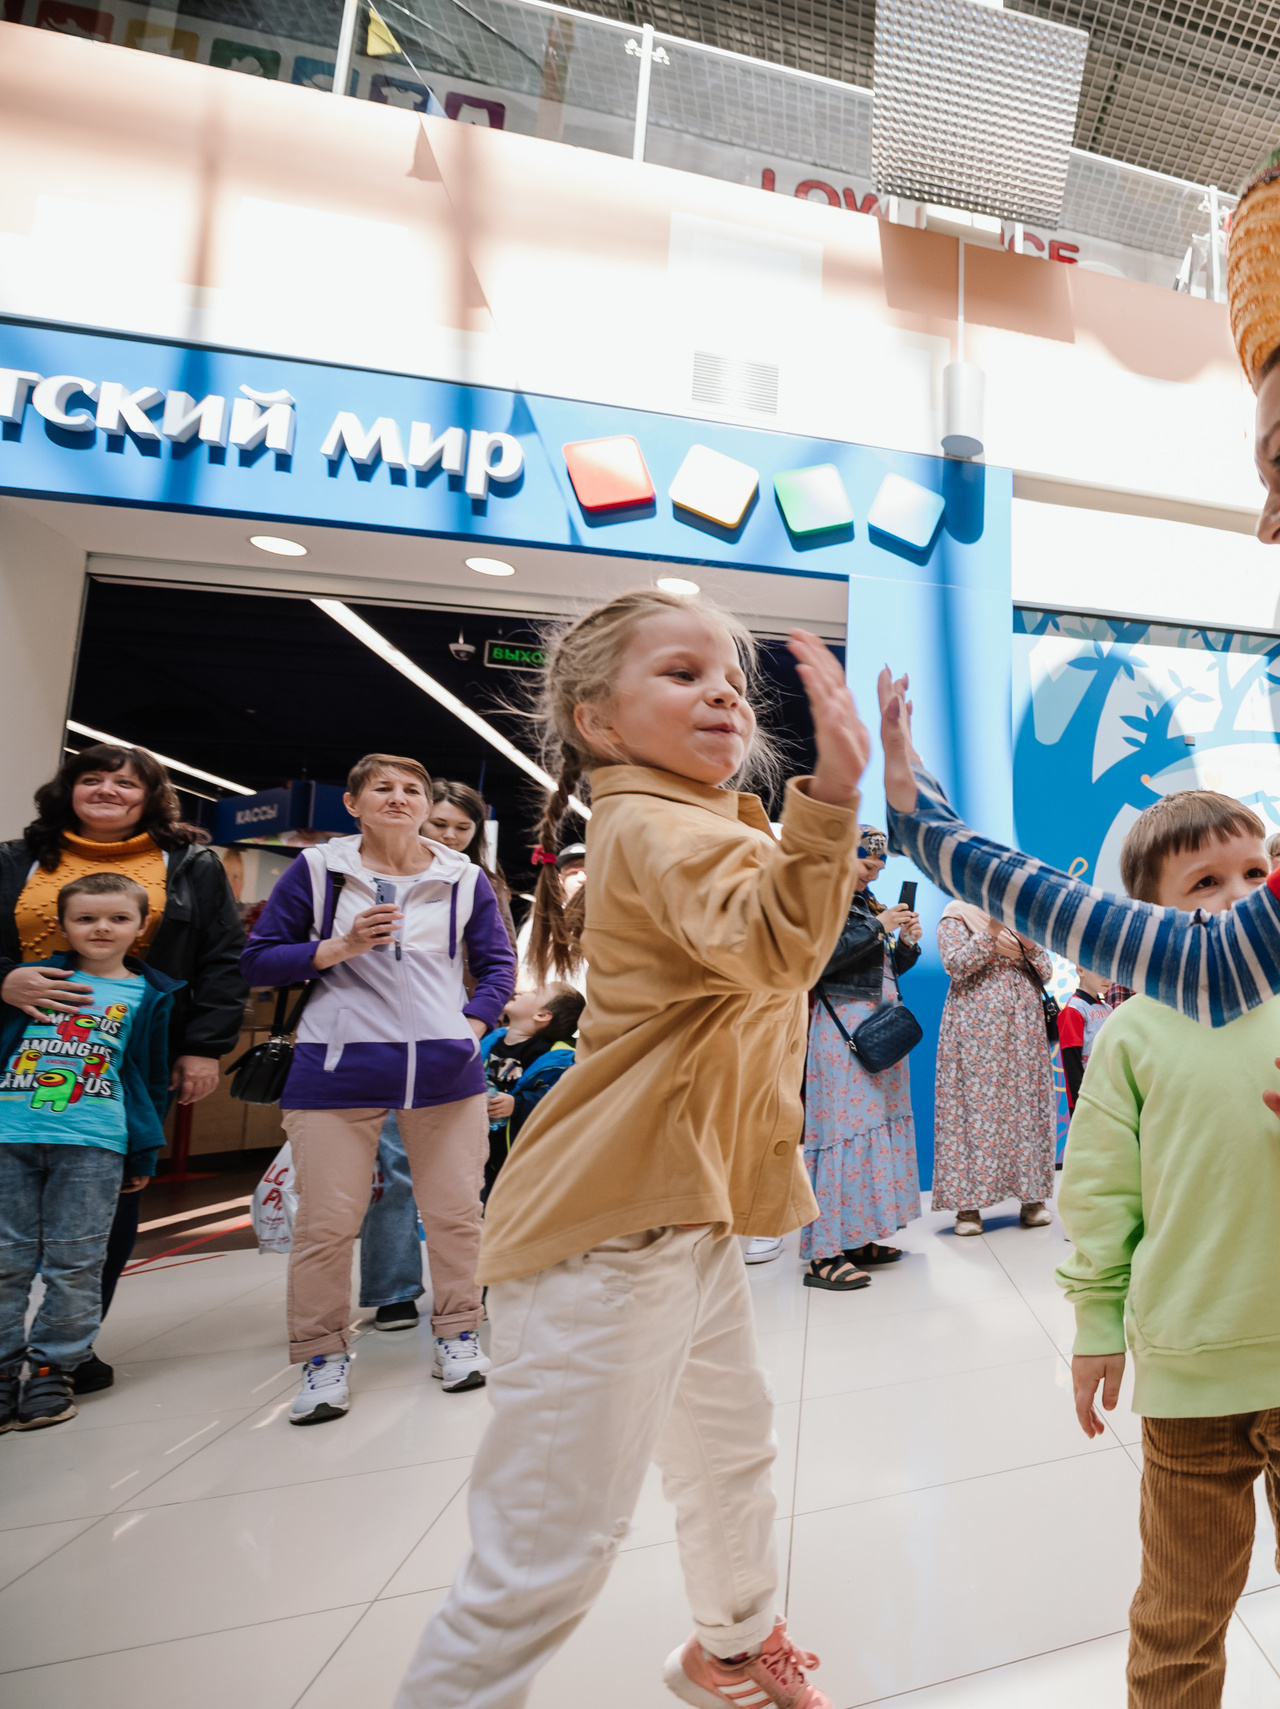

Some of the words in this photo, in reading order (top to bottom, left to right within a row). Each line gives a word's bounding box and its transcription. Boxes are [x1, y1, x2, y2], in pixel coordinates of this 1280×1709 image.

[320, 410, 525, 500] мир
[492, 647, 548, 666] ВЫХО
[235, 803, 278, 825] КАССЫ
